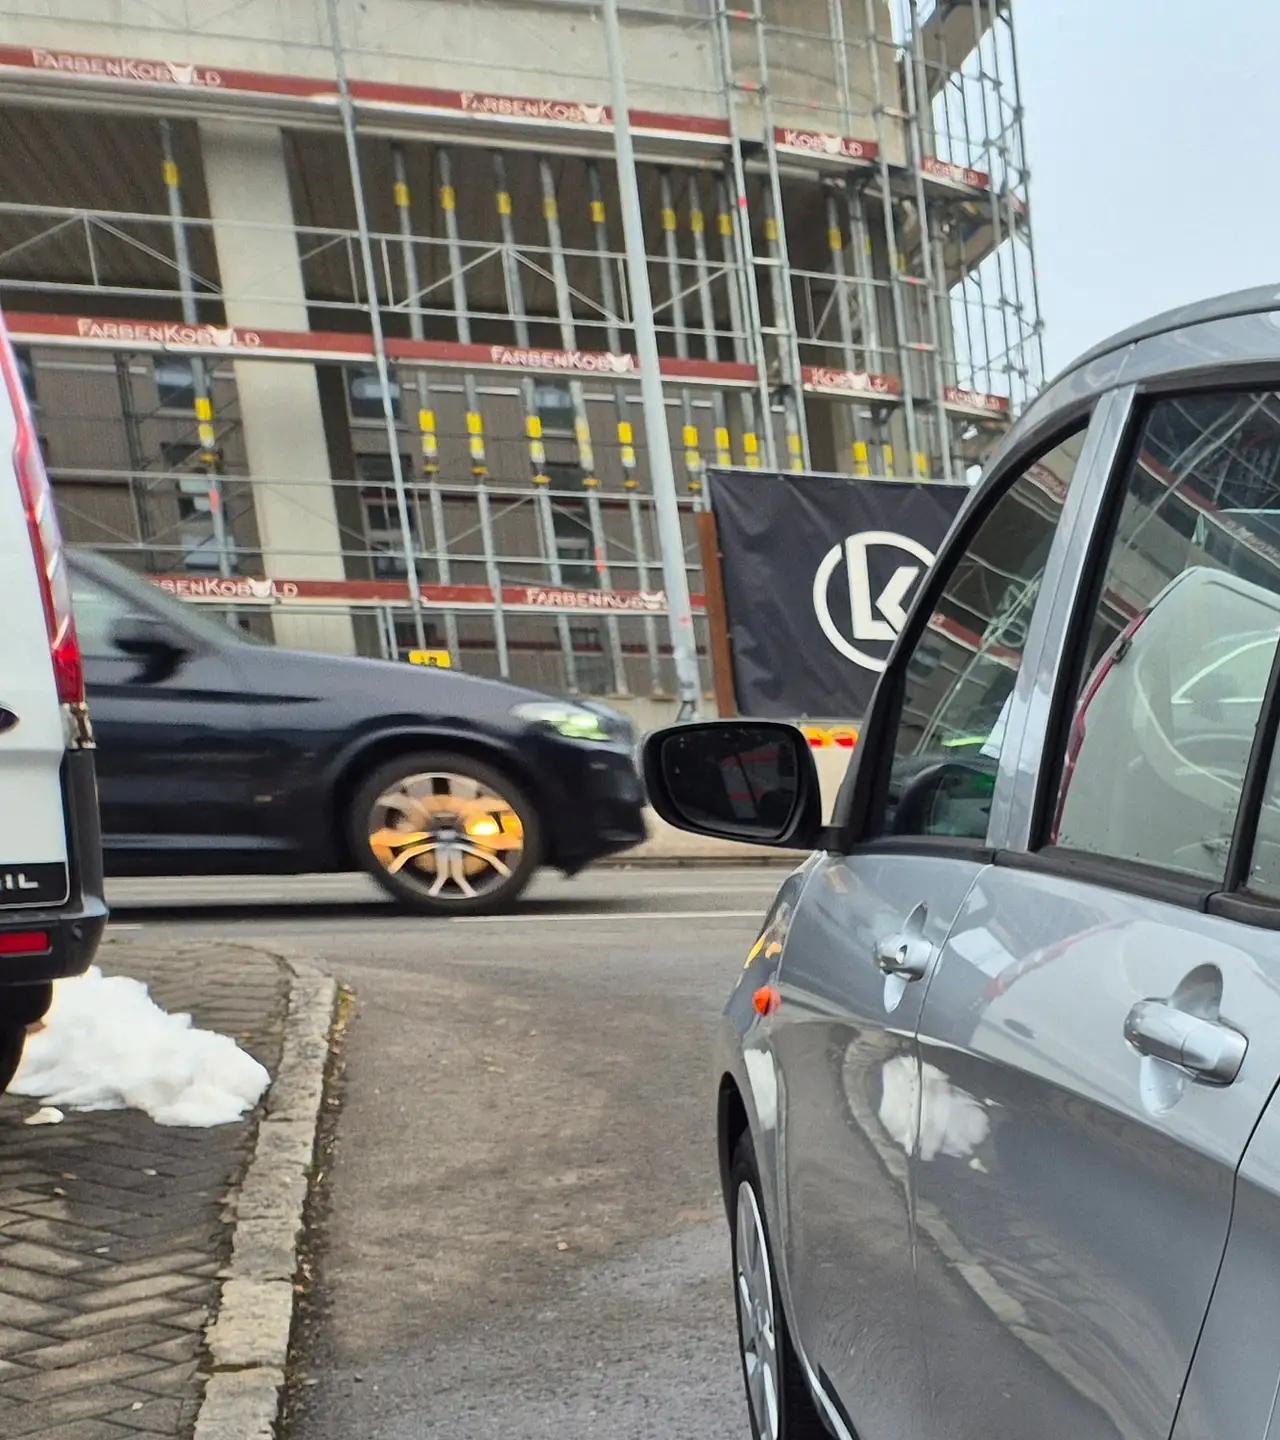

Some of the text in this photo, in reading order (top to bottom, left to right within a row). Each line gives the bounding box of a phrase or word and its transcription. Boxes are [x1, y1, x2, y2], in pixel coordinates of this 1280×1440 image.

[460, 91, 614, 125] FARBENKOBOL
[490, 345, 635, 373] FARBENKOBO
[158, 577, 299, 598] BENKOBOLD
